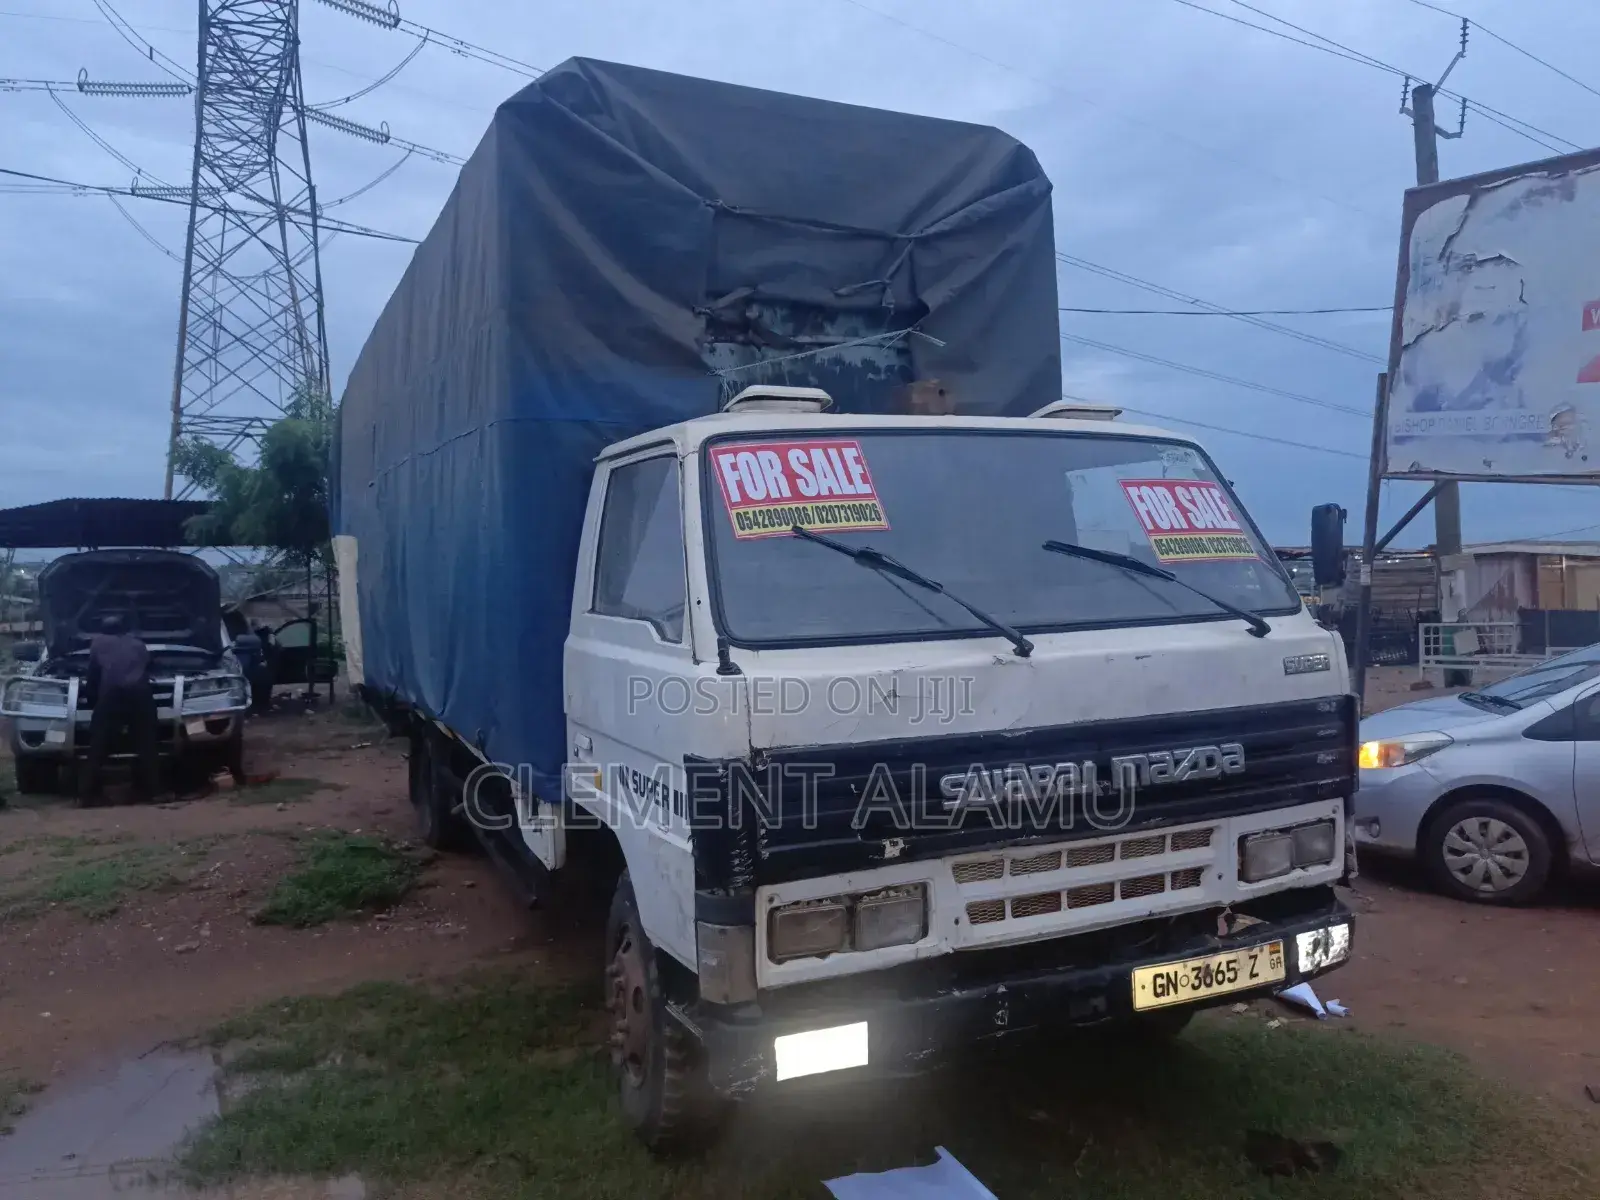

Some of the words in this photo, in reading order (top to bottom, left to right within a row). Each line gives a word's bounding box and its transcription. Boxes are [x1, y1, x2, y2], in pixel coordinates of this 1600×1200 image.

[717, 451, 792, 503] FOR
[787, 447, 873, 497] SALE
[1126, 485, 1190, 531] FOR
[1174, 485, 1242, 530] SALE
[631, 768, 670, 812] SUPER
[1152, 970, 1179, 999] GN
[1190, 959, 1239, 991] 3665
[1247, 953, 1260, 981] Z
